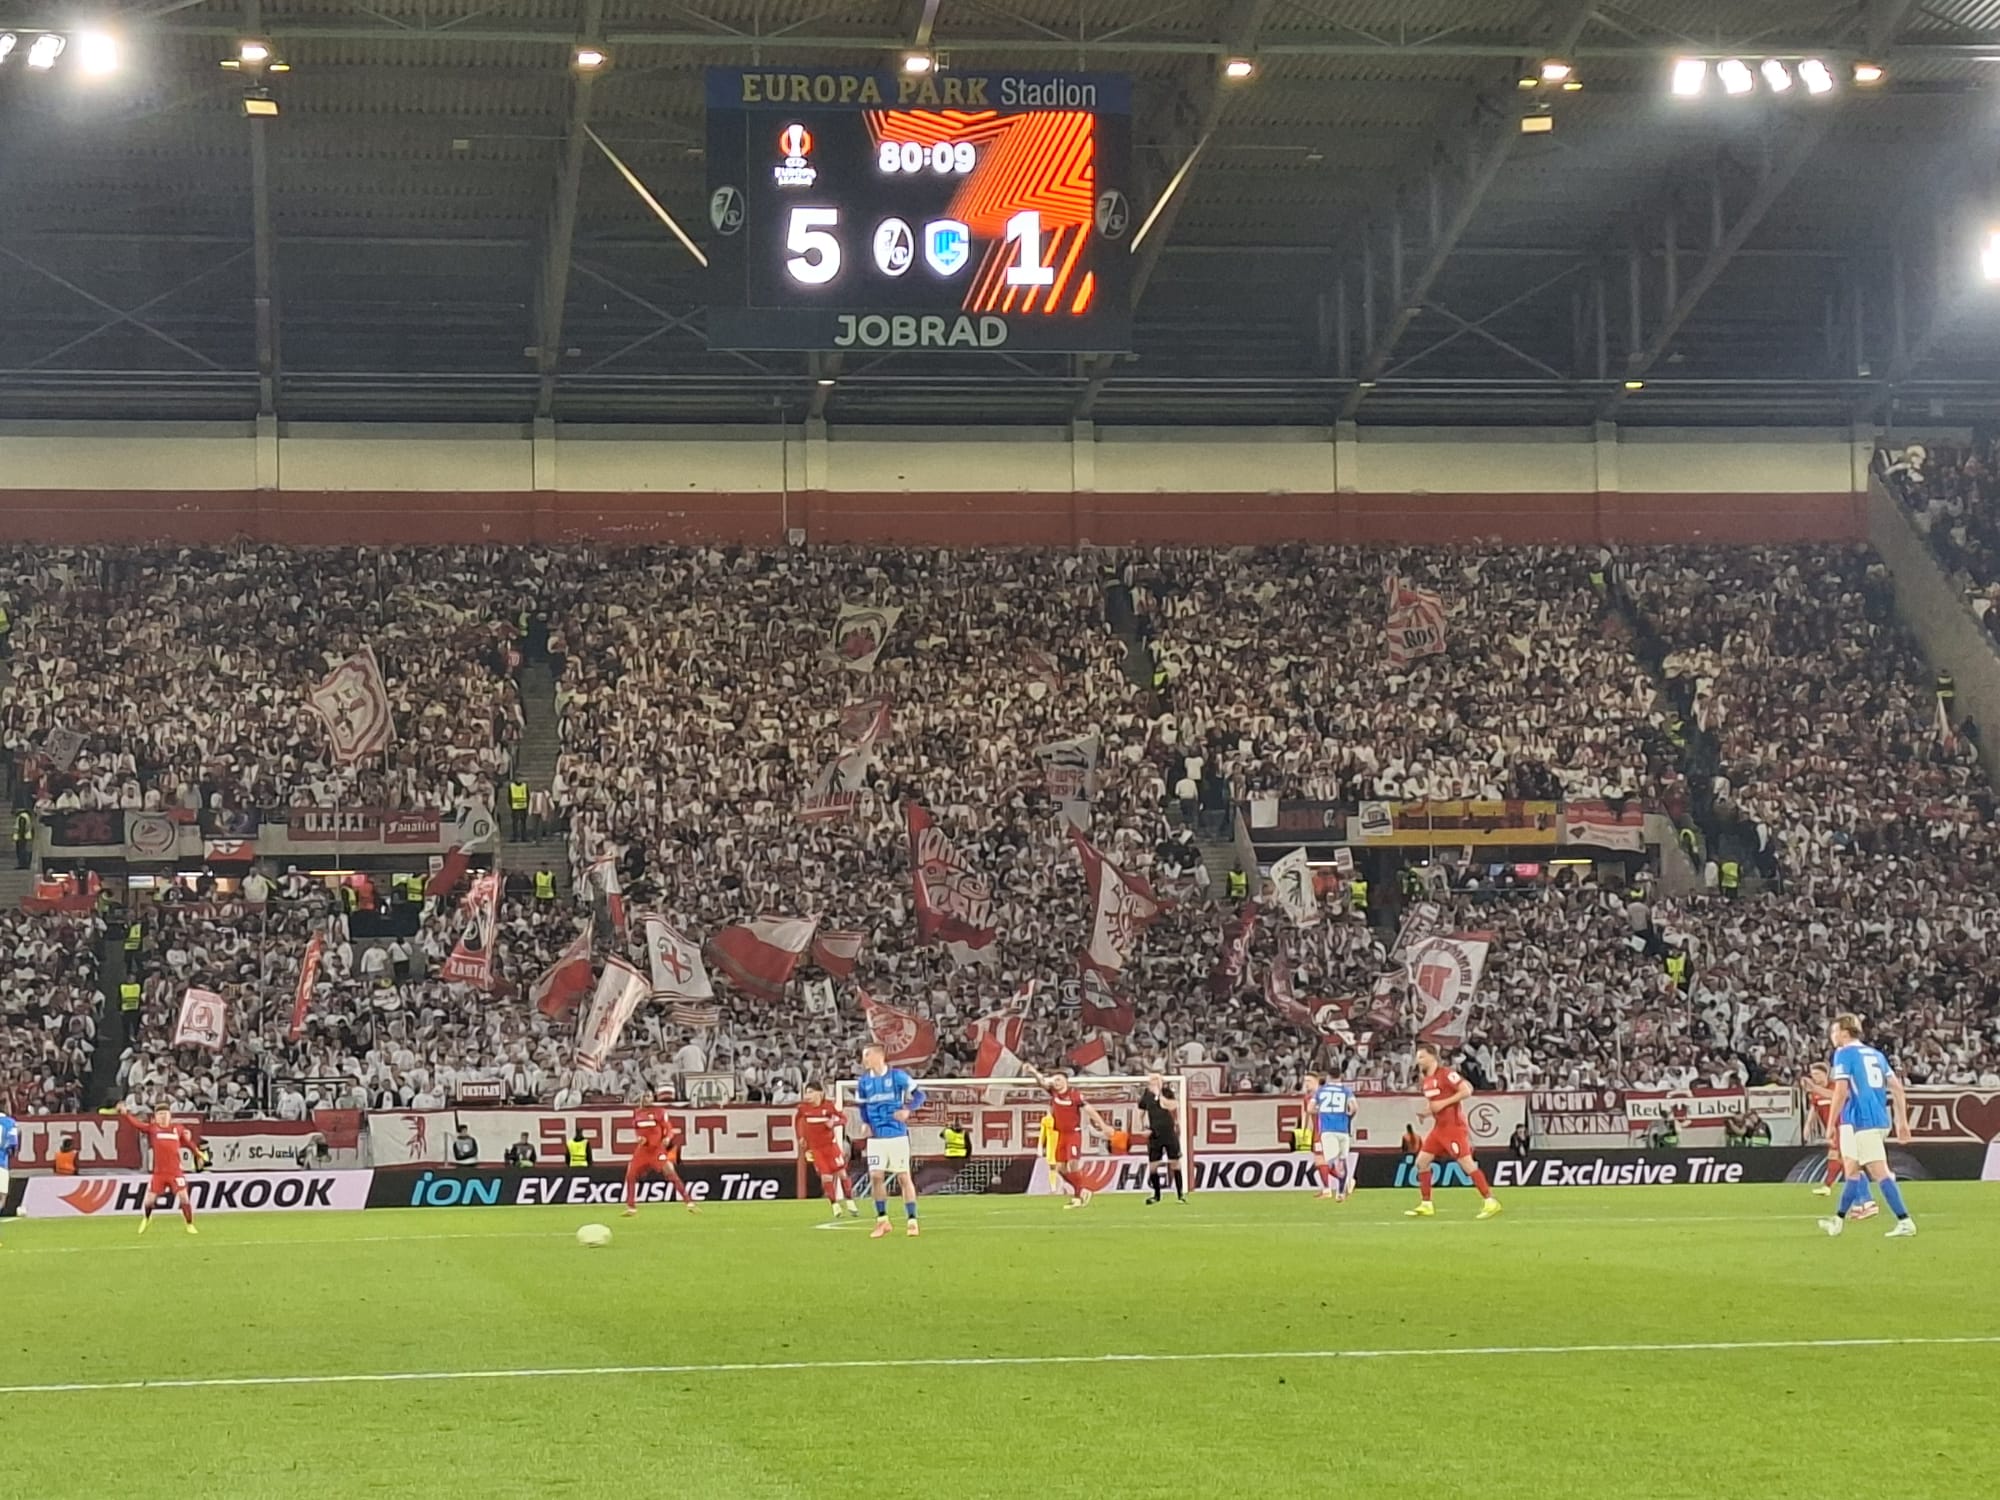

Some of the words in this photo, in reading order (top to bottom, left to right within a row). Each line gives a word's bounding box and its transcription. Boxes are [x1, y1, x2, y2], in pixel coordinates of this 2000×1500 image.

[742, 73, 882, 103] EUROPA
[897, 76, 990, 105] PARK
[1000, 77, 1097, 106] Stadion
[878, 140, 977, 173] 80:09
[786, 207, 842, 284] 5
[1006, 210, 1054, 285] 1
[834, 314, 1008, 347] JOBRAD
[1863, 1055, 1884, 1088] 6
[1318, 1091, 1346, 1113] 29
[1531, 1092, 1597, 1111] FIGHT
[1631, 1102, 1663, 1118] Red
[1697, 1099, 1742, 1116] Label
[1493, 1159, 1538, 1186] EV
[1540, 1157, 1677, 1186] Exclusive
[1687, 1157, 1744, 1183] Tire
[515, 1176, 565, 1205] EV
[719, 1172, 780, 1202] Tire
